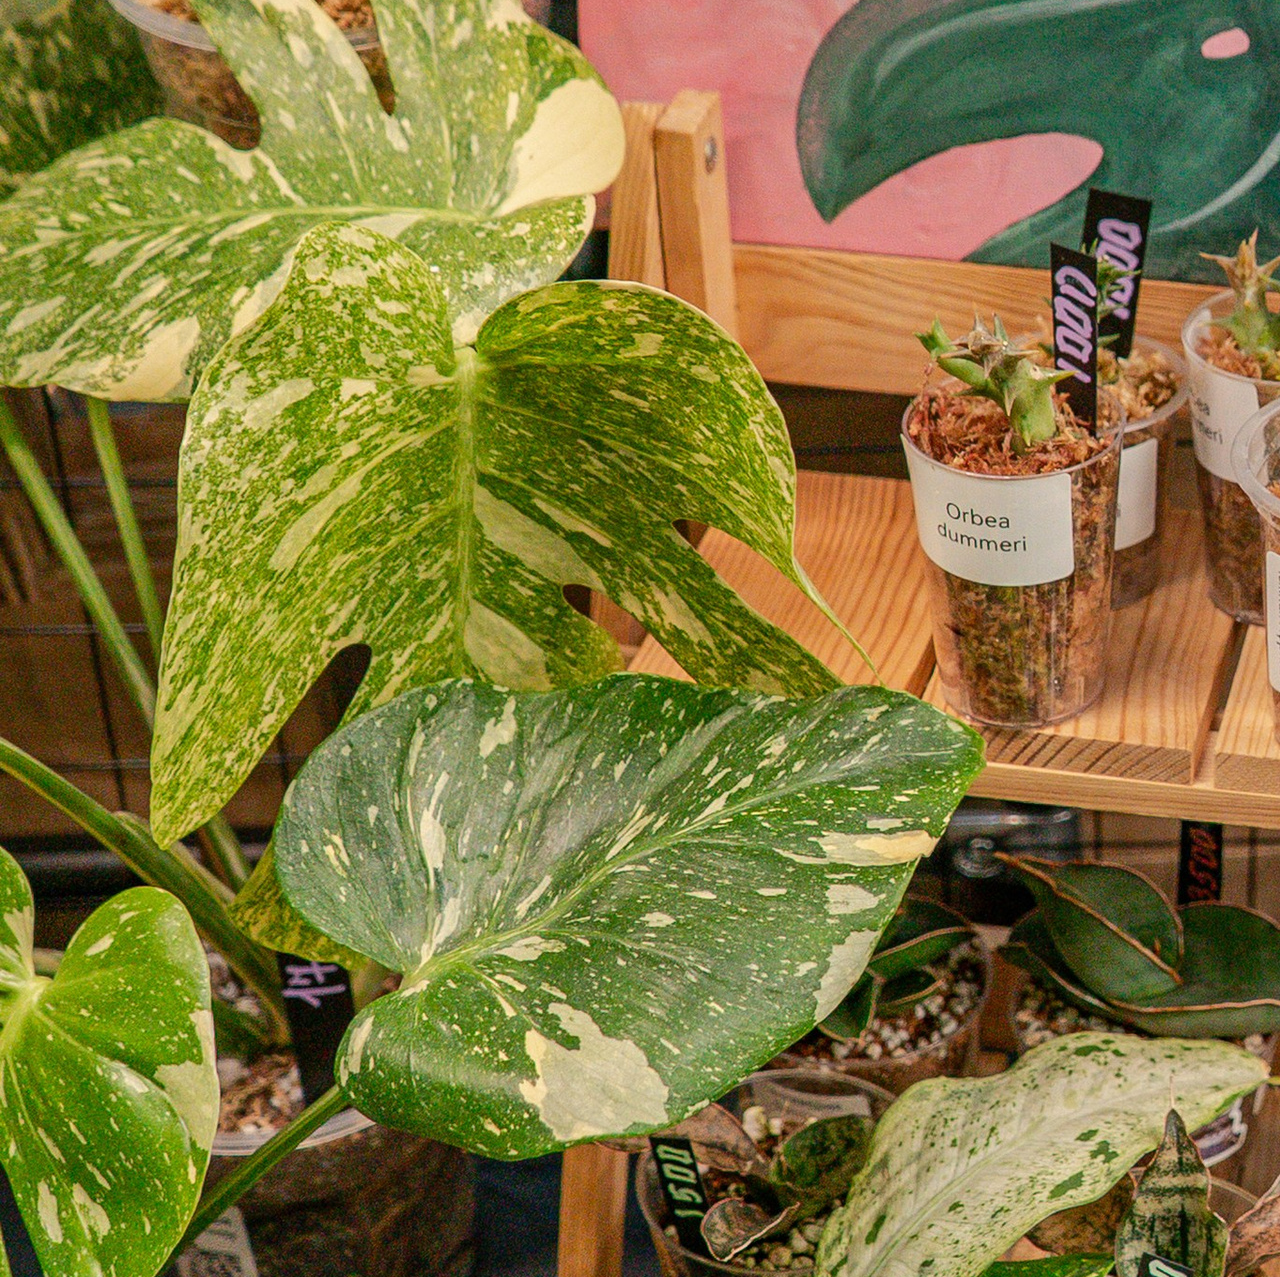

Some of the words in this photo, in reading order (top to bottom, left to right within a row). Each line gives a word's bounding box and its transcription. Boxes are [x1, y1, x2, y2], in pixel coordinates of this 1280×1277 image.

[946, 502, 1010, 529] Orbea
[938, 522, 1027, 552] dummeri
[657, 1143, 704, 1219] 1500
